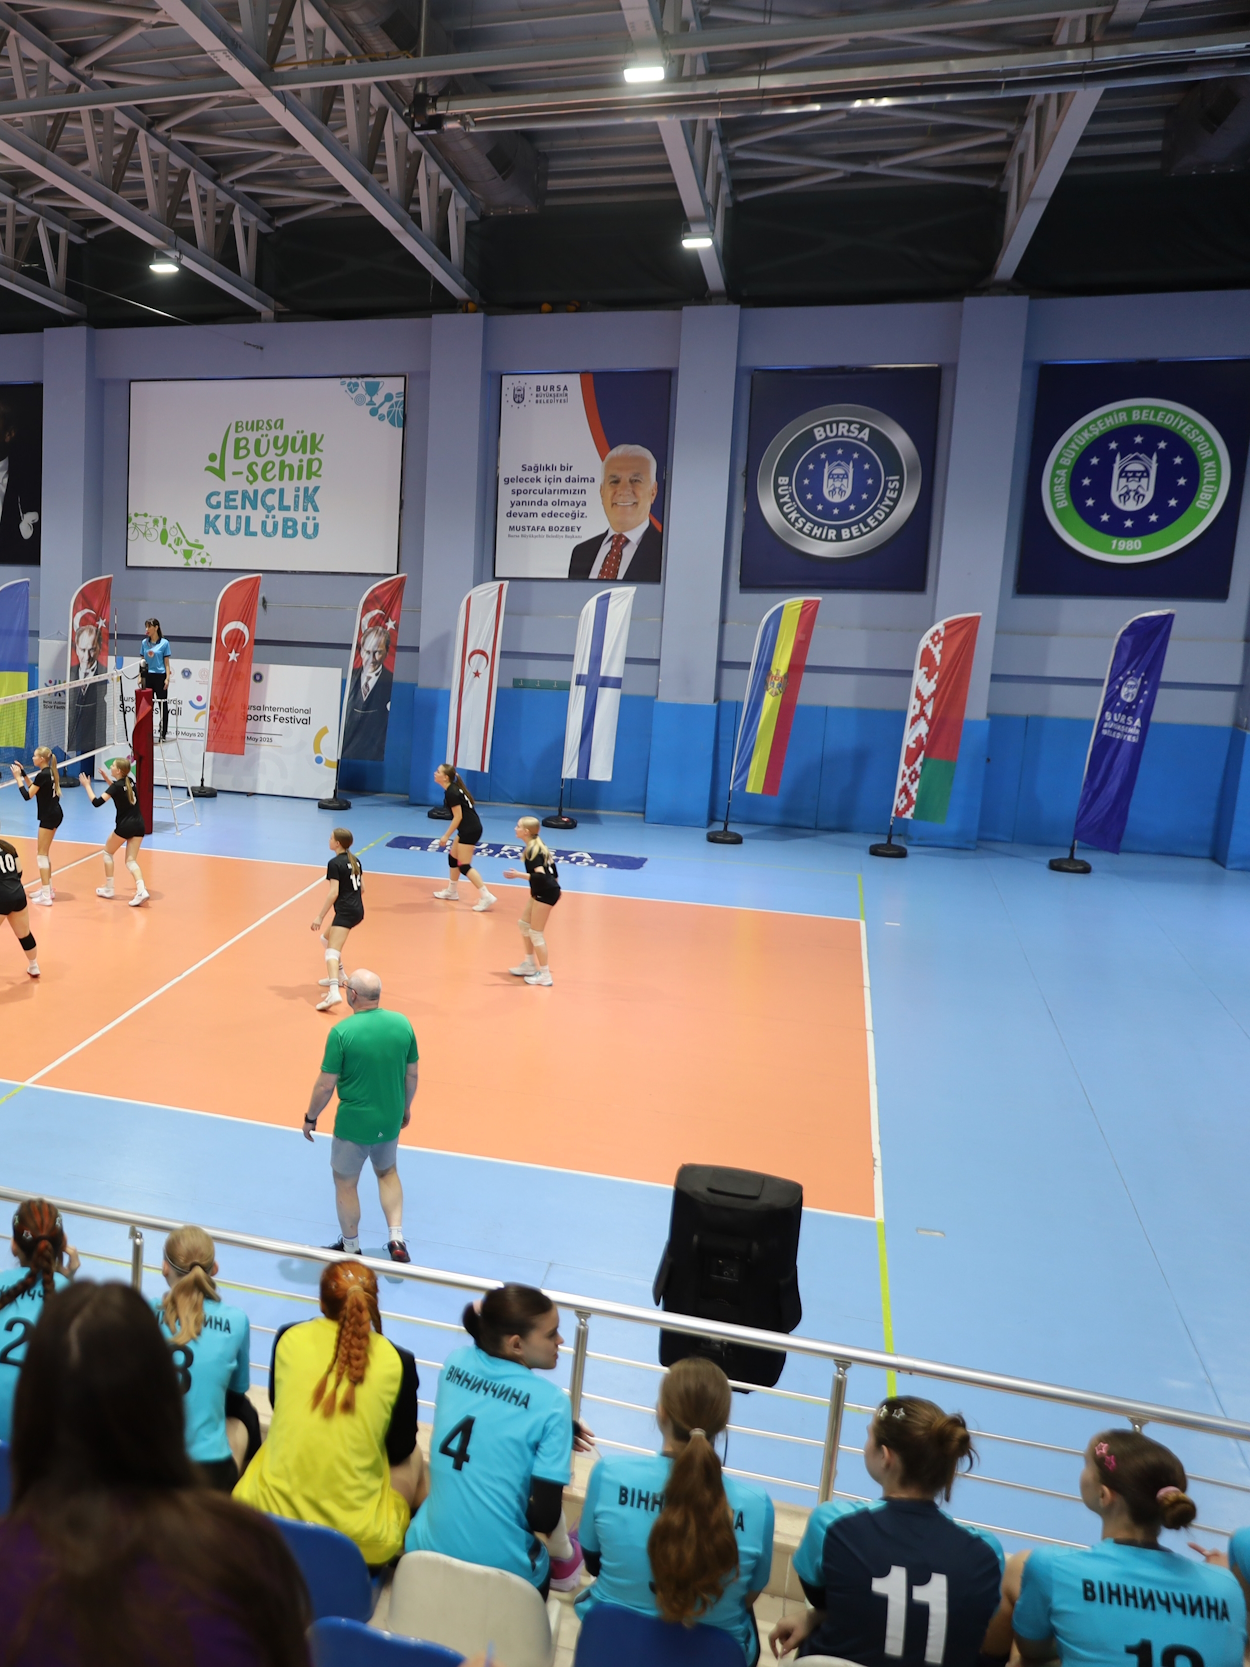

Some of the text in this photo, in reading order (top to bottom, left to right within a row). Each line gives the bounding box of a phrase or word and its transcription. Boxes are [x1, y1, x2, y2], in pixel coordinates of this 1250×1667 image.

[536, 384, 569, 392] BURSA
[813, 422, 870, 442] BURSA
[1053, 409, 1217, 510] BURSA BÜYÜKŞEHİR BELEDİYESPOR KULÜBÜ
[521, 463, 573, 473] Sağlıklı bir
[503, 475, 595, 485] gelecek için daima
[205, 486, 321, 513] GENÇLİK
[511, 487, 587, 497] sporcularımızın
[509, 499, 587, 509] yanında olmaya
[777, 475, 900, 540] BÜYÜKŞEHİR BELEDİYESİ
[505, 510, 588, 520] devam edeceğiz.
[204, 514, 320, 540] KULÜBÜ
[1111, 538, 1142, 551] 1980
[262, 704, 312, 715] International
[273, 714, 311, 726] Festival
[1105, 711, 1142, 728] BURSA
[246, 735, 258, 743] May
[445, 1365, 531, 1410] ВІННИЧЧИНА
[438, 1414, 477, 1472] 4
[1081, 1578, 1231, 1623] ВІННИЧЧИНА
[871, 1564, 948, 1665] 11
